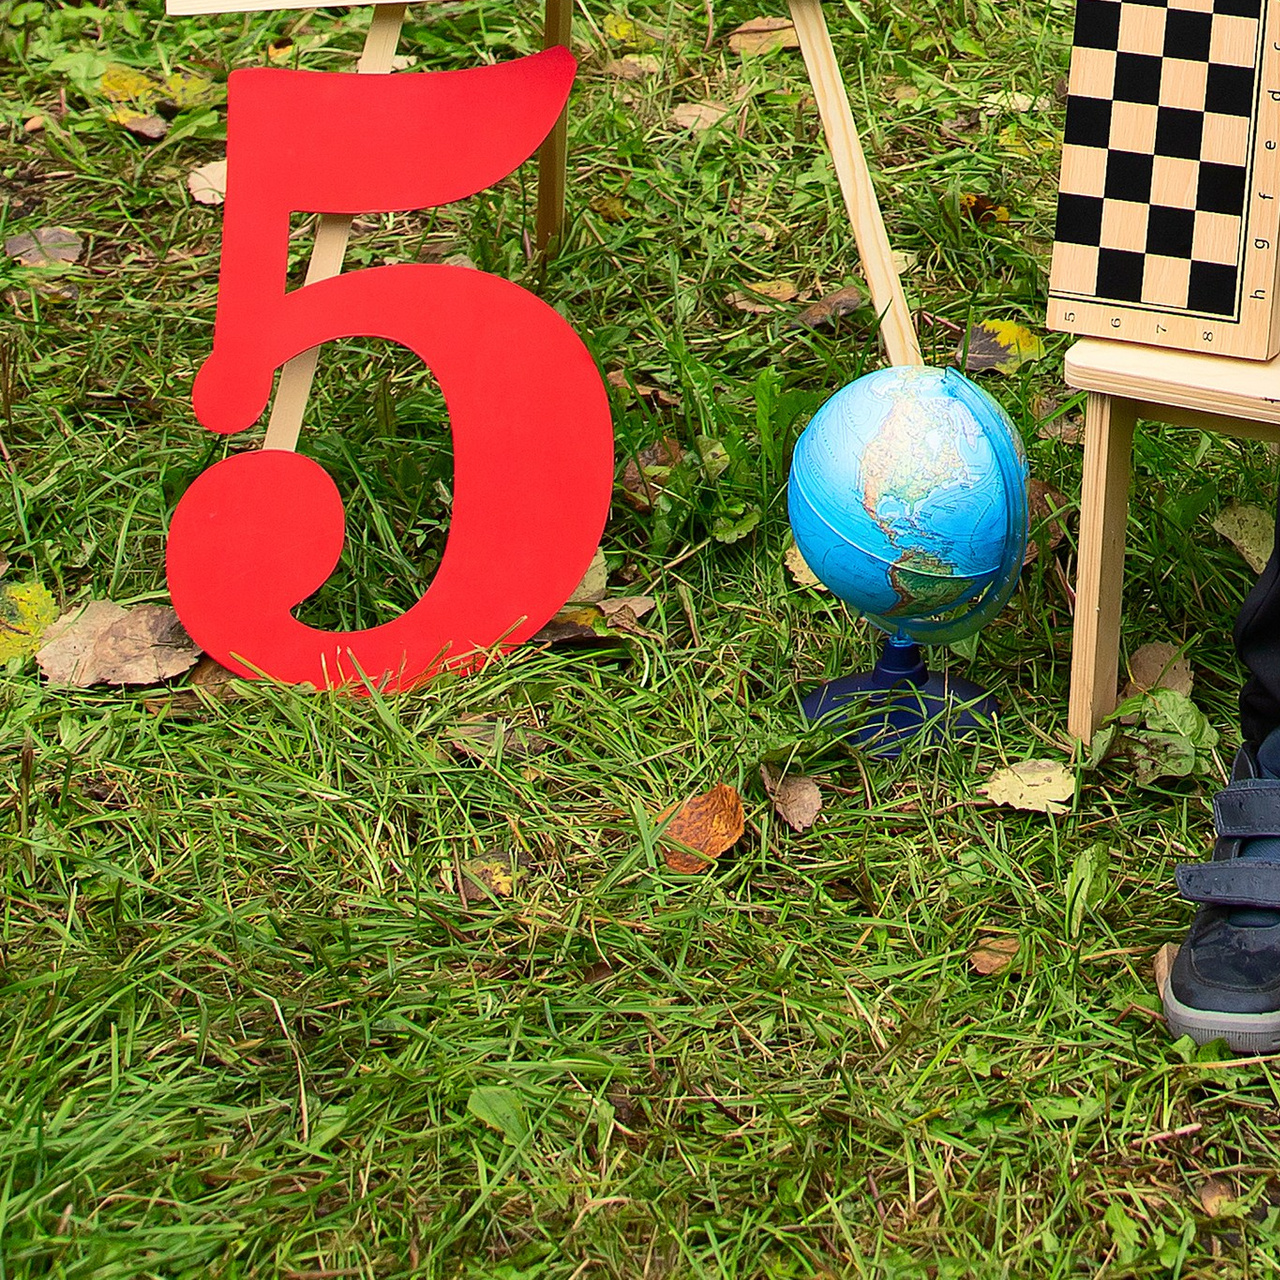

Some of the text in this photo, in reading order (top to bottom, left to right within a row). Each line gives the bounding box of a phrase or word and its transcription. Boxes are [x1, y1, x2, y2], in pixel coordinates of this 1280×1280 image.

[1265, 140, 1277, 150] e
[1258, 192, 1274, 200] f
[1254, 238, 1270, 250] g
[1250, 289, 1266, 300] h
[1064, 311, 1214, 342] 5 6 7 8
[166, 44, 614, 695] 5
